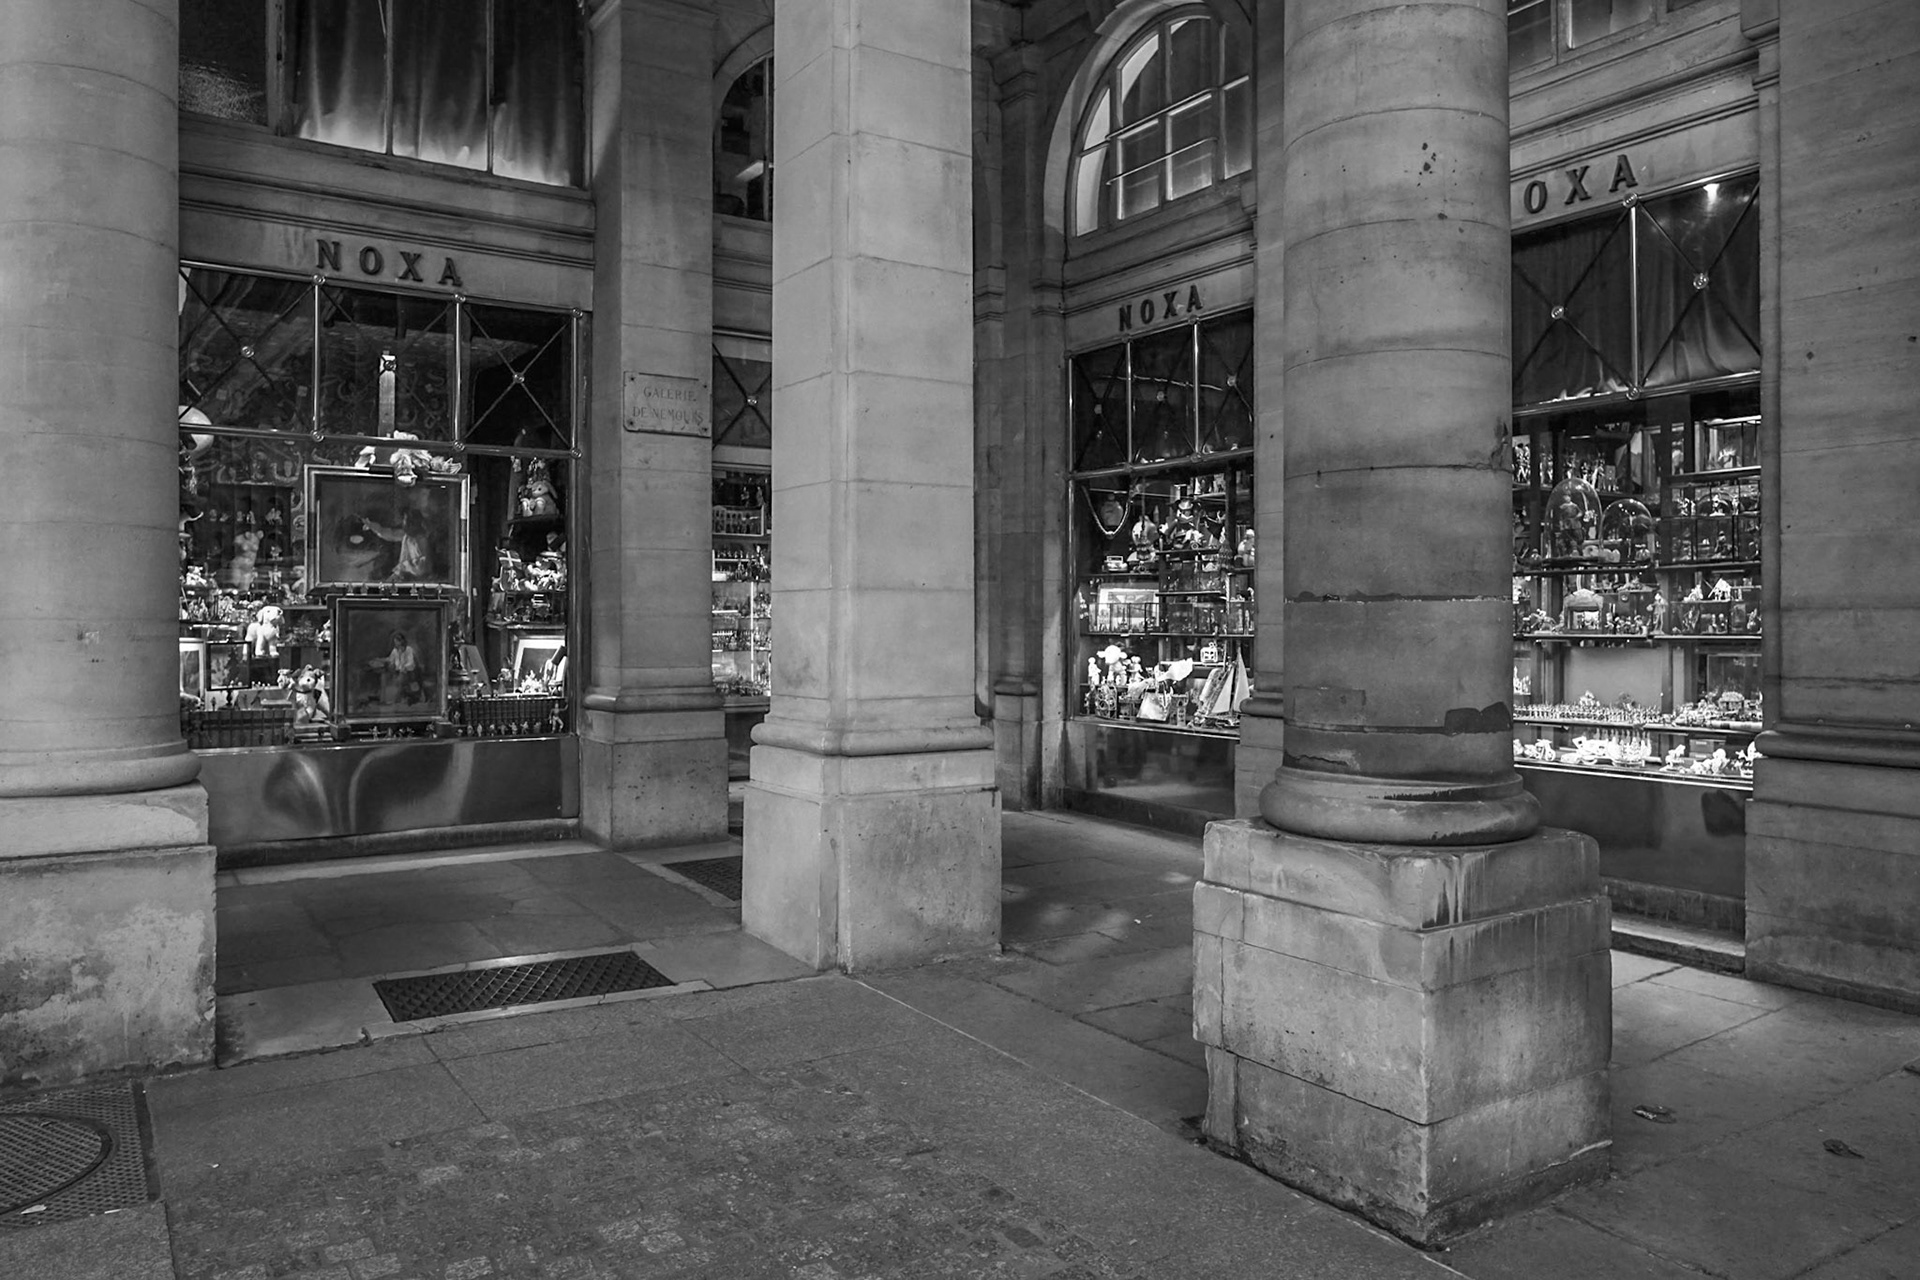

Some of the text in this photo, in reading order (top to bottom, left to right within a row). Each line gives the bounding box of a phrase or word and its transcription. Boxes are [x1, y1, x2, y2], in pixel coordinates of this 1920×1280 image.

[1523, 154, 1638, 214] OXA
[316, 239, 464, 288] NOXA
[1118, 285, 1203, 331] NOXA
[632, 406, 648, 418] DE
[643, 386, 697, 402] GALERIE
